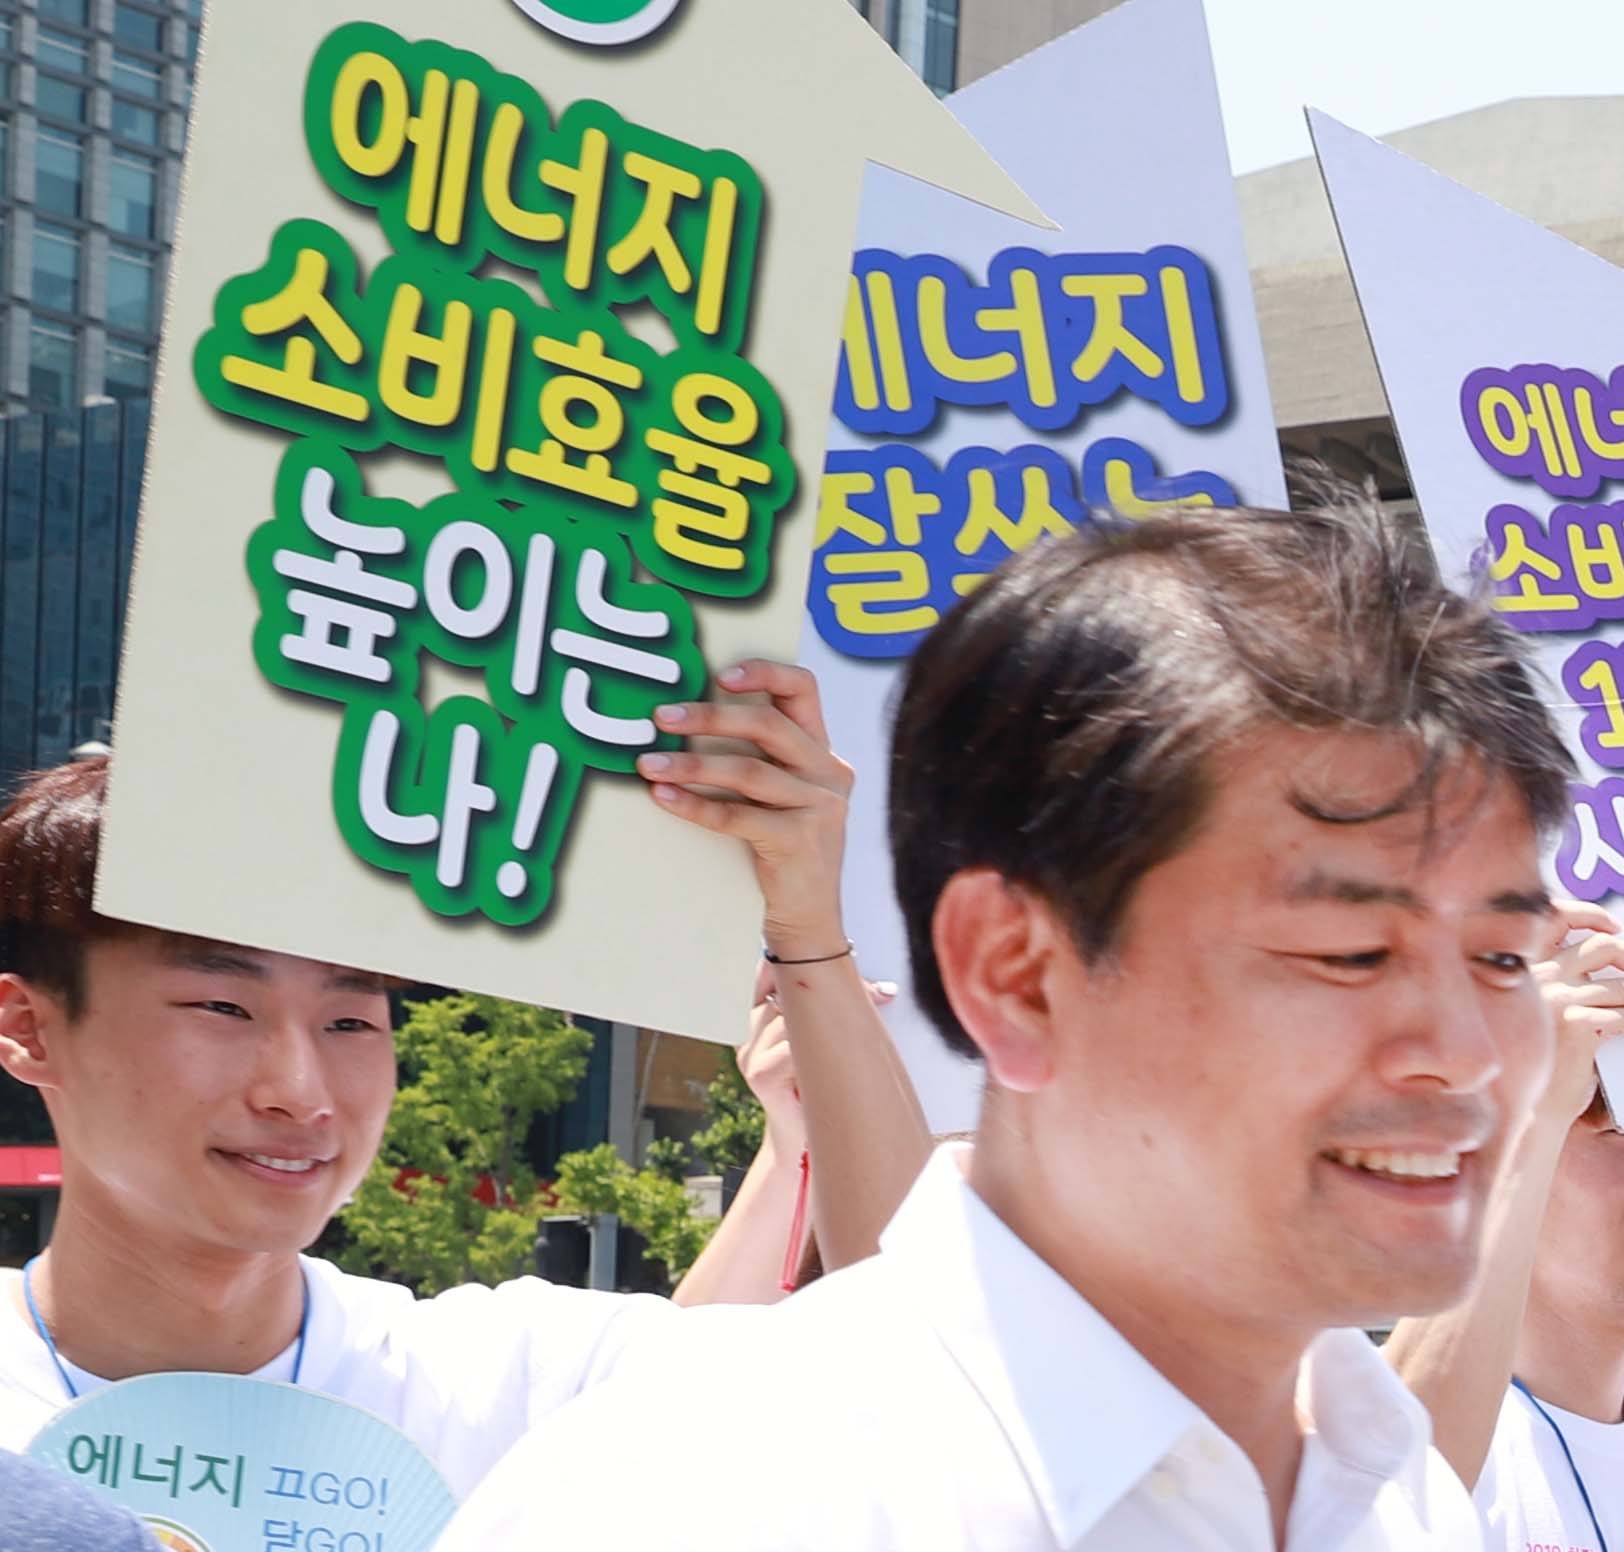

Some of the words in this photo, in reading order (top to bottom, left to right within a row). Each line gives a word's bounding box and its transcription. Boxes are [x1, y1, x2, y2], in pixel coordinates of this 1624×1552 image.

[331, 51, 736, 335] 에너지
[221, 248, 771, 571] 소비효율
[273, 466, 679, 745] 높이는
[359, 710, 558, 898] 나!
[68, 1434, 245, 1508] 에너지
[264, 1465, 388, 1516] 끄GO!
